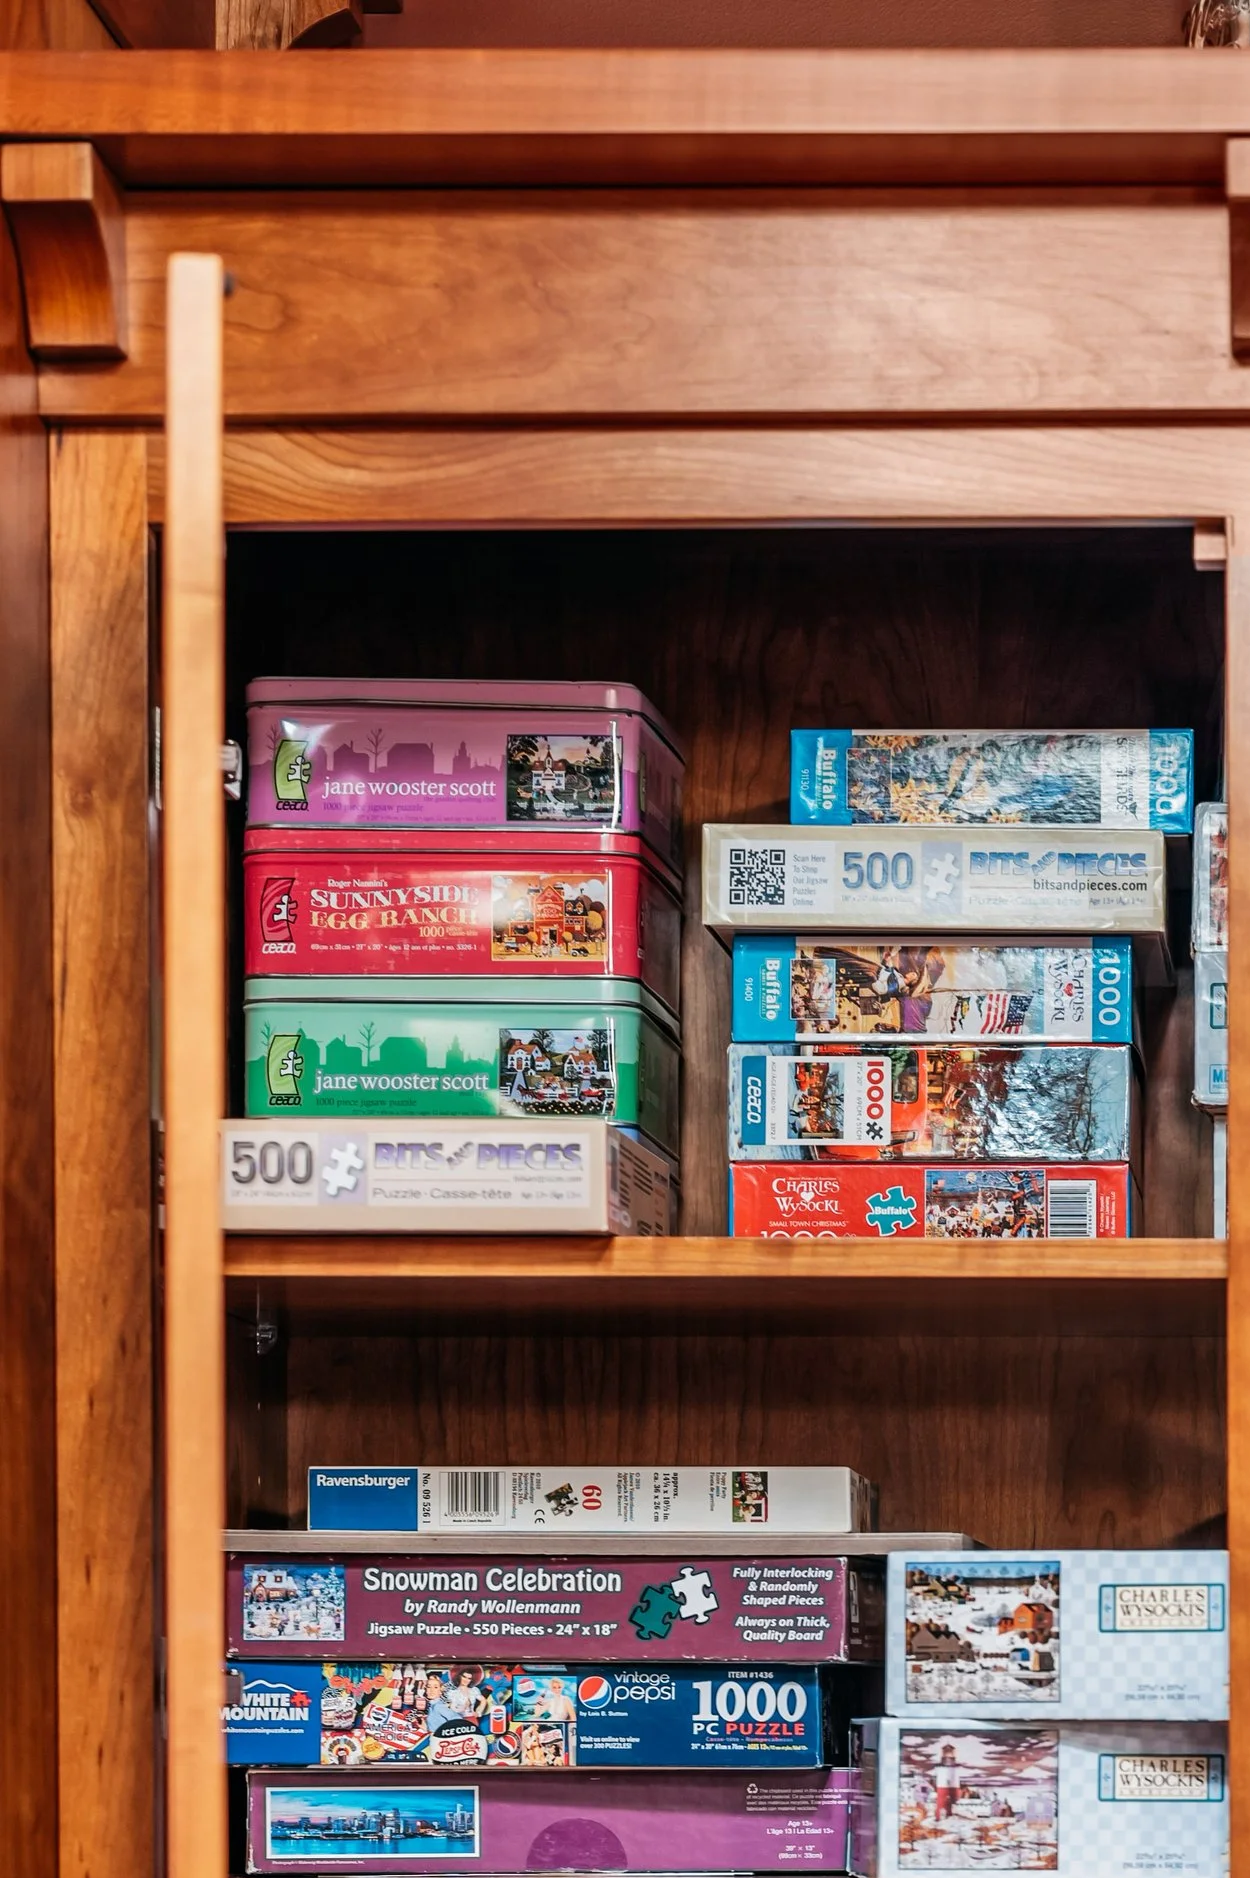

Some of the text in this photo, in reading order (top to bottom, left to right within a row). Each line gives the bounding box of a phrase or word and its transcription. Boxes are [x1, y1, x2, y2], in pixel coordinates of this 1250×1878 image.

[322, 777, 496, 799] jane wooster scott
[801, 768, 809, 790] 91130
[823, 749, 836, 810] Buffalo
[842, 852, 913, 889] 500
[970, 851, 1147, 876] BITS AND PIECES
[1033, 878, 1147, 892] bitsandpieces.com
[310, 886, 478, 909] SUNNYSIDE
[765, 959, 779, 1021] Buffalo
[1099, 952, 1120, 1026] 1000
[314, 1071, 488, 1093] jane wooster scott
[867, 1061, 884, 1119] 1000
[232, 1141, 314, 1184] 500
[373, 1188, 512, 1200] Puzzle Casse-tête
[317, 1474, 410, 1488] Ravensburger
[582, 1485, 602, 1510] 60
[364, 1568, 622, 1592] Snowman Celebration
[733, 1568, 833, 1580] Fully Interlocking
[748, 1581, 818, 1593] & Randomly
[1119, 1589, 1204, 1602] CHARLES
[404, 1599, 581, 1616] by Randy Wollenmann
[742, 1595, 824, 1607] Shaped Pieces
[1120, 1604, 1204, 1618] WYSOCKI'S
[735, 1616, 776, 1628] Always
[796, 1617, 830, 1628] Thick,
[743, 1630, 823, 1642] Quality Board
[614, 1672, 670, 1686] vintage
[614, 1683, 676, 1703] pepsi
[692, 1681, 807, 1722] 1000
[693, 1724, 804, 1735] PC PUZZLE
[1119, 1759, 1204, 1772] CHARLES
